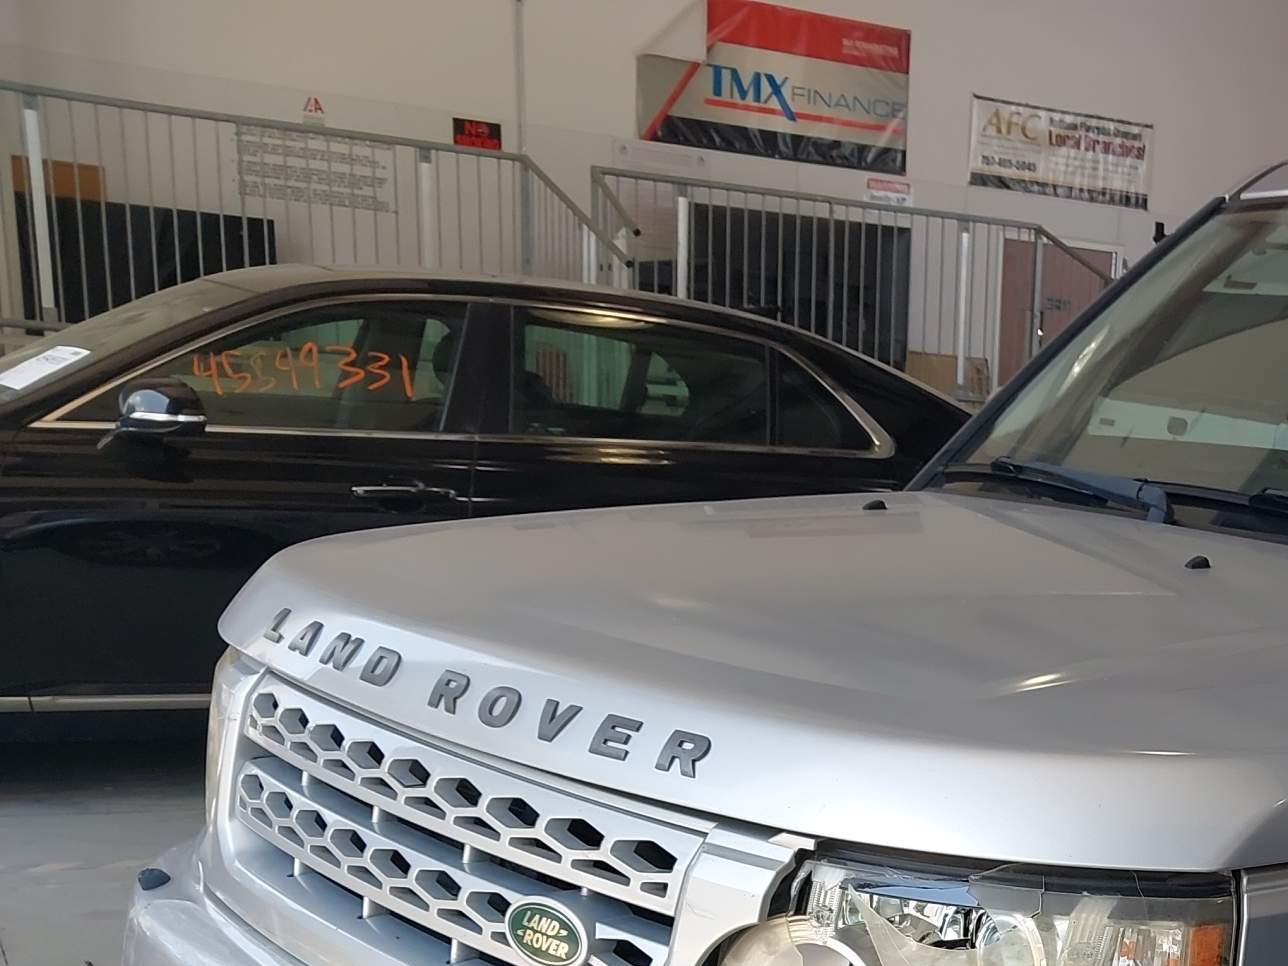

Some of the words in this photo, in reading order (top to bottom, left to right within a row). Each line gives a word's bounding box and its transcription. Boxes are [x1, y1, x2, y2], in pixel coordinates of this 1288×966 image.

[706, 63, 797, 122] TMX
[982, 107, 1042, 141] AFC
[263, 606, 403, 688] LAND
[426, 668, 712, 779] ROVER
[521, 909, 561, 937] LAND
[522, 928, 570, 960] ROVER
